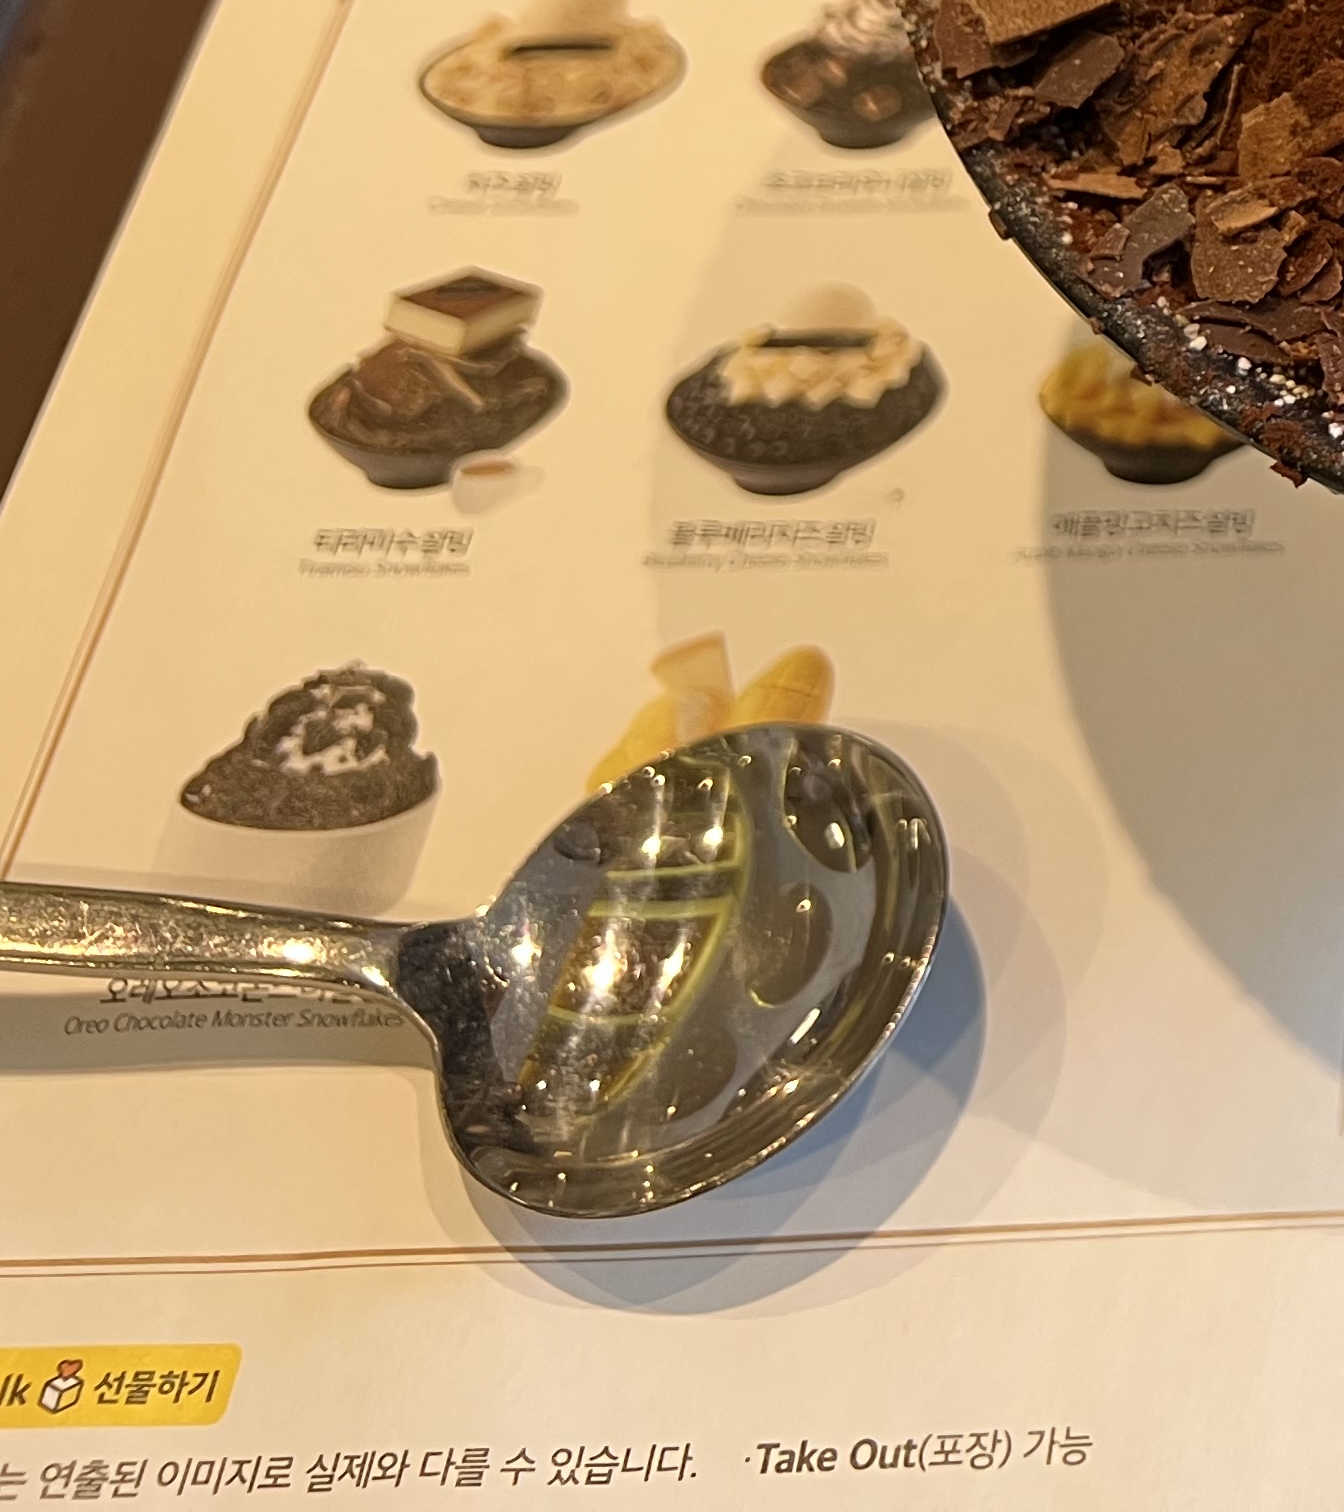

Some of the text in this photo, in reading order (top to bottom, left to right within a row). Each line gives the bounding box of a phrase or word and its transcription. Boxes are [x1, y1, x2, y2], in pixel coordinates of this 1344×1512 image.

[64, 1016, 109, 1035] Oreo
[114, 1009, 206, 1033] Chocolate
[211, 1009, 290, 1029] Monster
[94, 1369, 220, 1405] 선물하기
[1023, 1426, 1093, 1467] 가능
[39, 1457, 149, 1500] 연출된
[156, 1454, 294, 1496] 이미지로
[305, 1448, 410, 1492] 실제와
[419, 1446, 490, 1488] 다를
[500, 1447, 536, 1487] 수
[547, 1442, 697, 1487] 있습니다.
